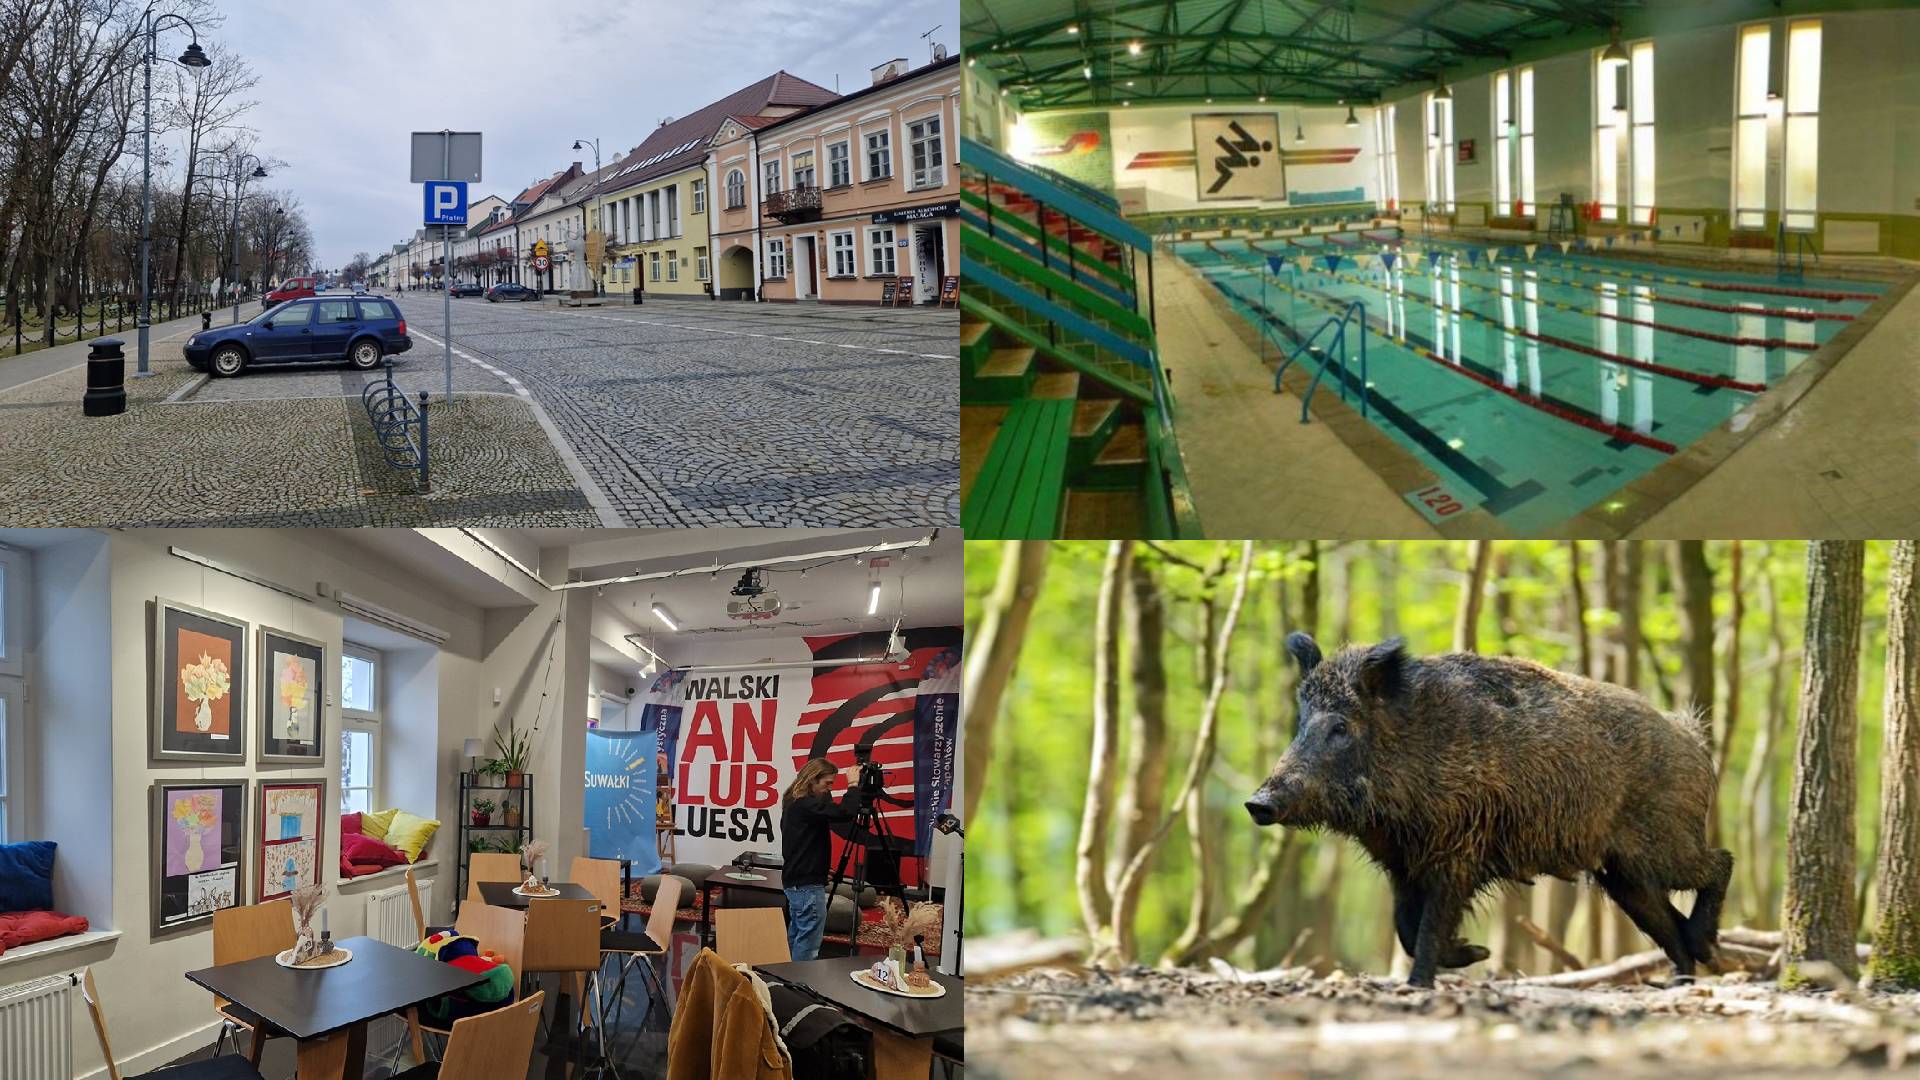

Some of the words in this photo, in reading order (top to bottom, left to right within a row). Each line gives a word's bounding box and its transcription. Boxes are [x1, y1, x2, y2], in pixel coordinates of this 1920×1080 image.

[434, 185, 458, 219] P
[537, 259, 547, 267] 30
[931, 697, 945, 788] Stowarzyszenie
[877, 969, 888, 982] 12
